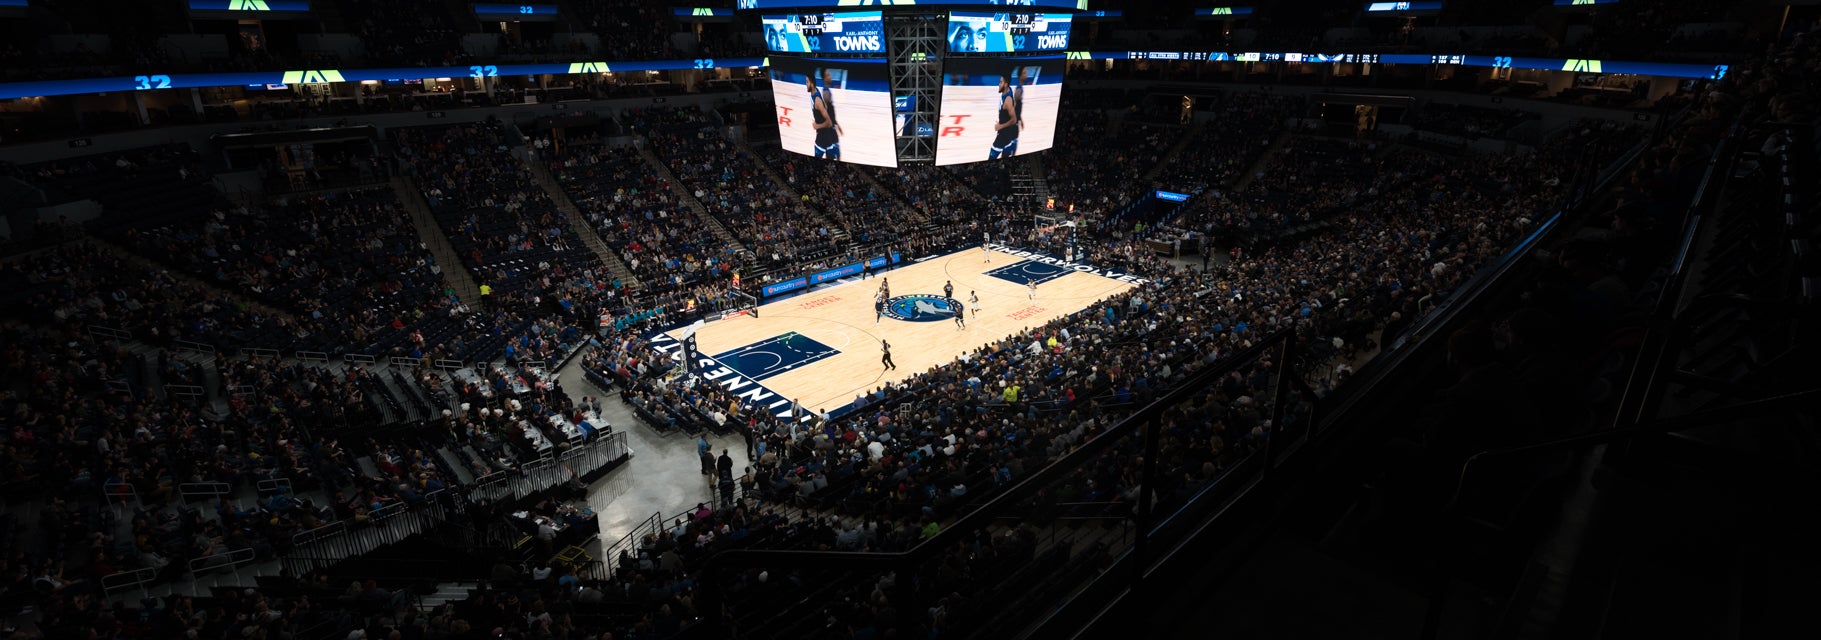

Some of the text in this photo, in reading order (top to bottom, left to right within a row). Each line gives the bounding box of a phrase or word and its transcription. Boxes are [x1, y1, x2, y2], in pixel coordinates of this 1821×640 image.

[520, 6, 534, 14] 32
[804, 14, 818, 25] 7:10
[1016, 14, 1029, 24] 7:10
[795, 23, 801, 32] 10
[823, 22, 828, 31] 9
[1002, 22, 1009, 31] 10
[1031, 22, 1036, 30] 9
[808, 35, 880, 51] 32 TOWNS
[1014, 35, 1067, 49] 32 TOWNS
[694, 58, 714, 69] 32
[1492, 56, 1512, 69] 32
[470, 64, 499, 78] 32
[135, 74, 172, 89] 32
